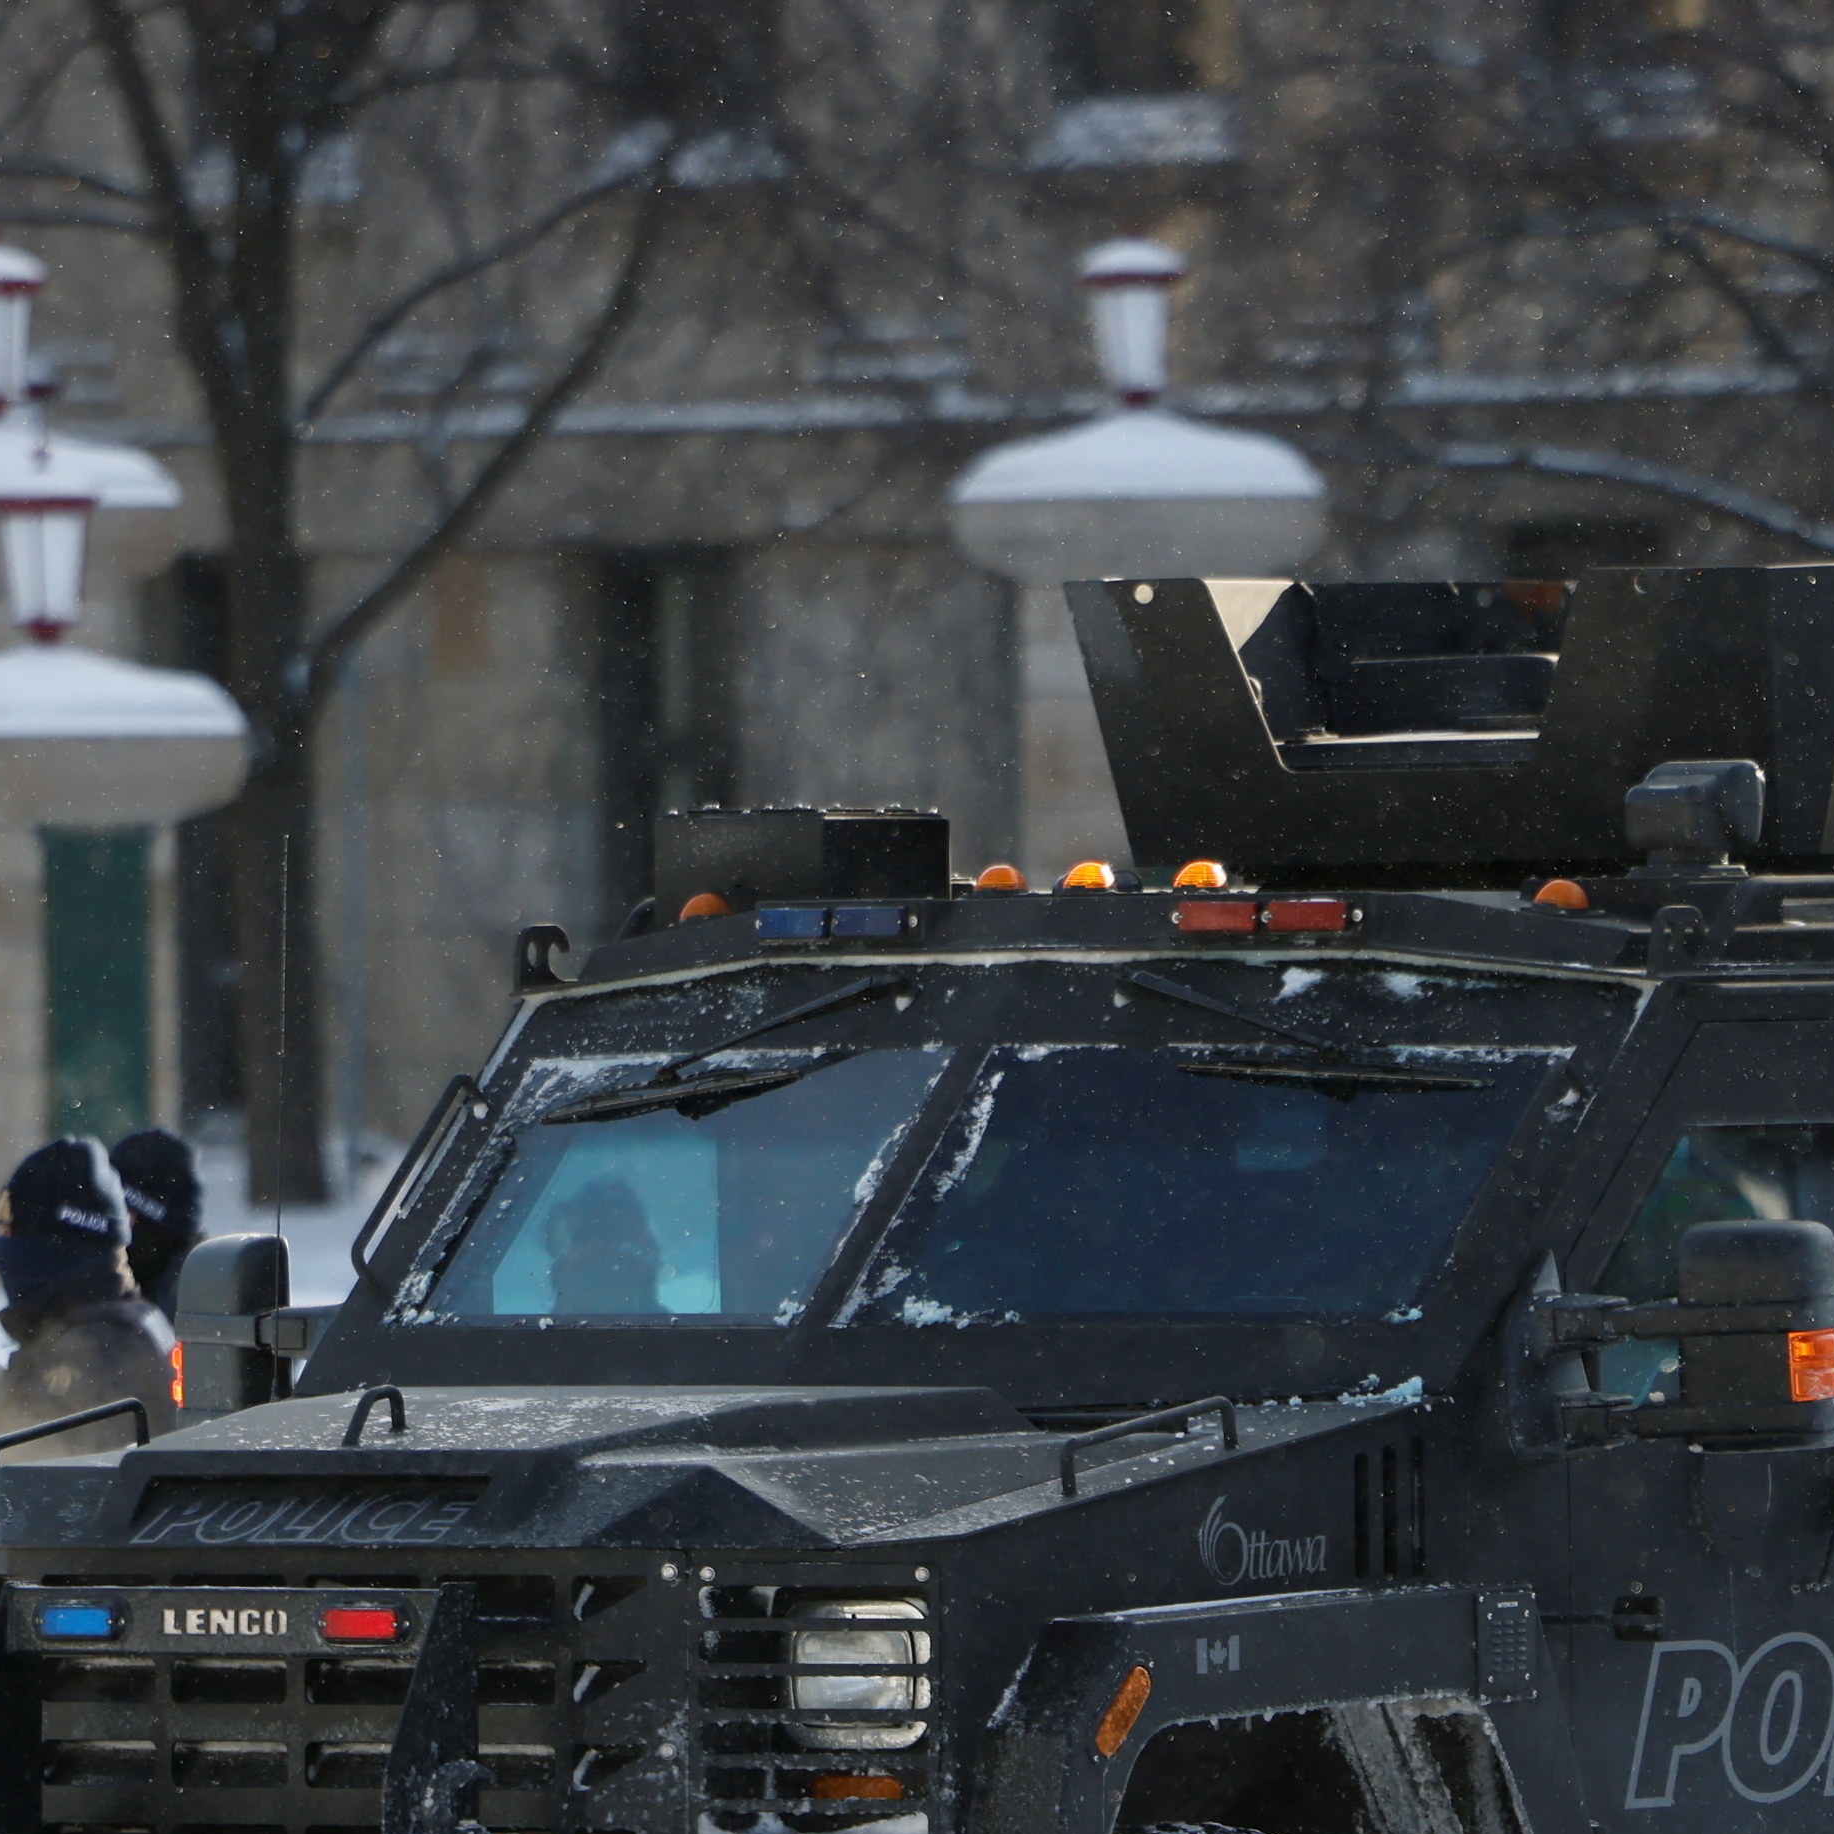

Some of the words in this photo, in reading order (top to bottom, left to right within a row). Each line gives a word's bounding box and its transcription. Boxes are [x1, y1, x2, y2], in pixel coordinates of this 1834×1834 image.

[58, 1203, 110, 1234] POLICE
[1199, 1494, 1327, 1586] Ottawa
[162, 1608, 289, 1636] LENCO
